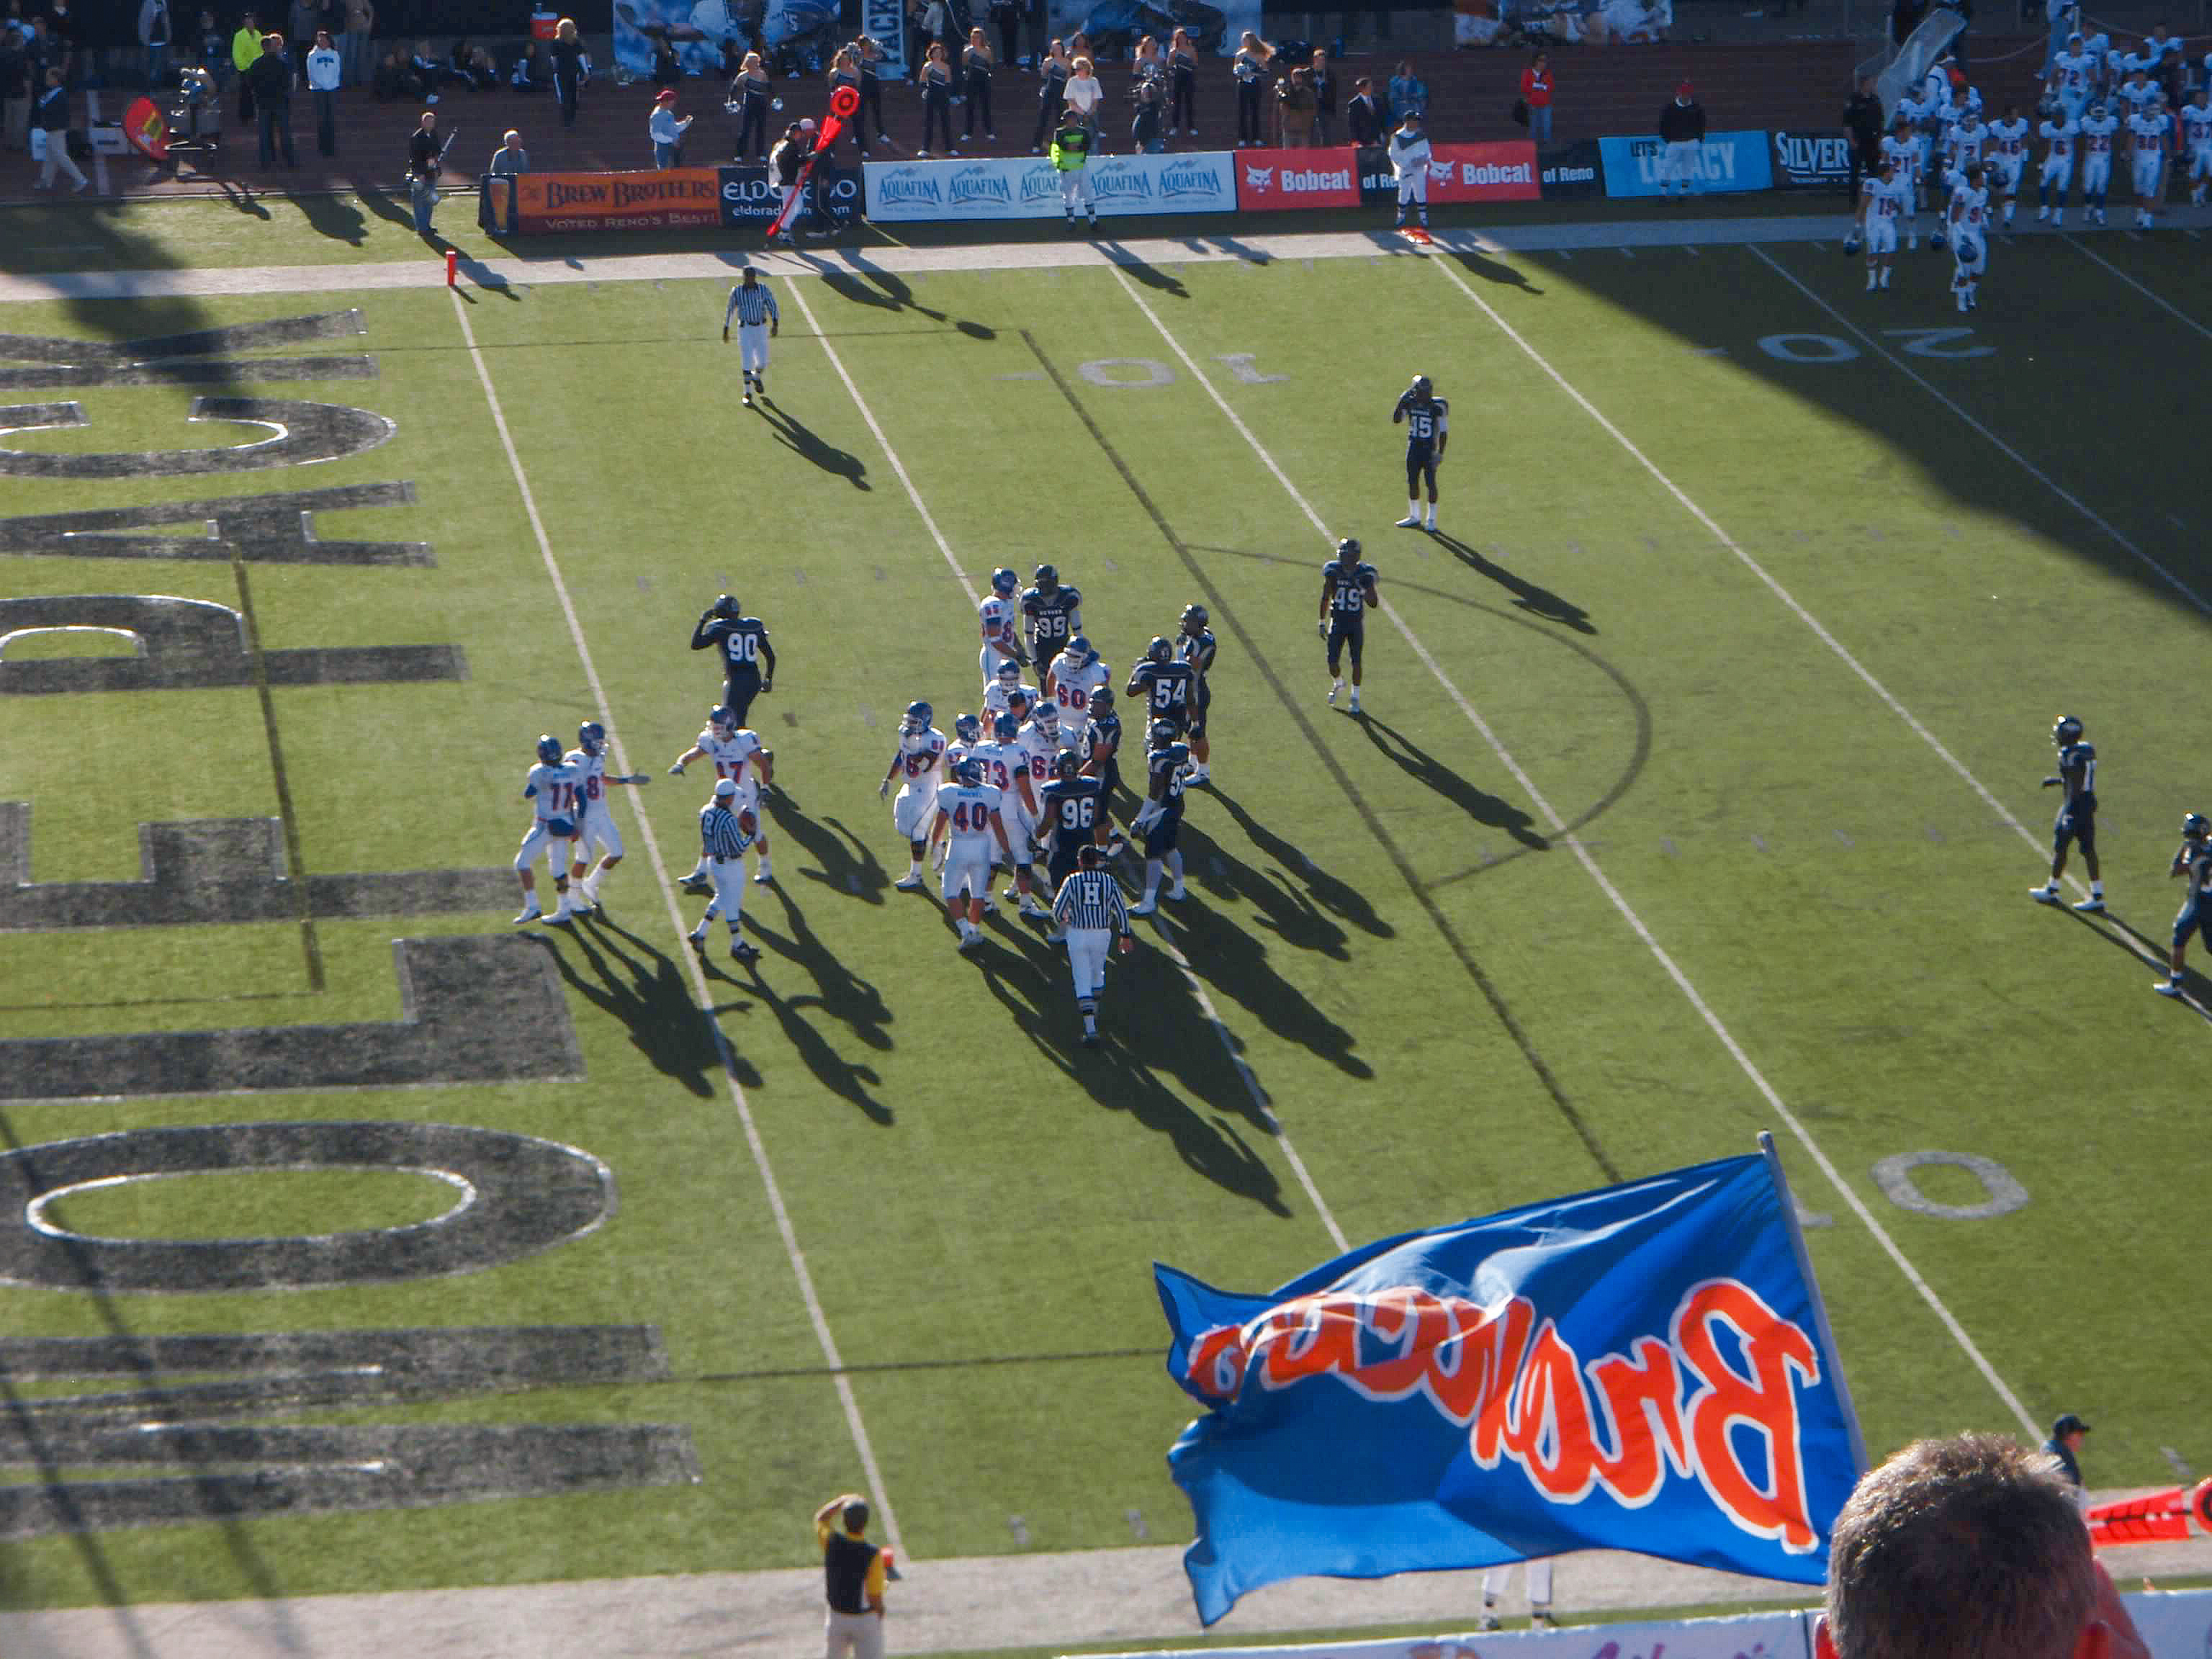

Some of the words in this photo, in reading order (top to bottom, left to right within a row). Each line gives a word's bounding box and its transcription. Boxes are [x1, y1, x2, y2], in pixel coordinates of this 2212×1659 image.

[1774, 132, 1850, 174] SILVER
[1159, 167, 1222, 196] AQUAFINA
[1281, 168, 1351, 191] Bobcat
[1362, 174, 1376, 189] of
[1462, 162, 1532, 185] Bobcat
[1542, 167, 1556, 183] of
[1559, 166, 1594, 181] Reno
[611, 179, 715, 209] BROTHERS
[878, 176, 943, 202] AQUAFINA
[949, 174, 1012, 202] AQUAFINA
[727, 632, 757, 662] 90
[1154, 678, 1186, 709] 54
[953, 801, 987, 832] 40
[1061, 797, 1095, 830] 96
[1082, 881, 1101, 905] H
